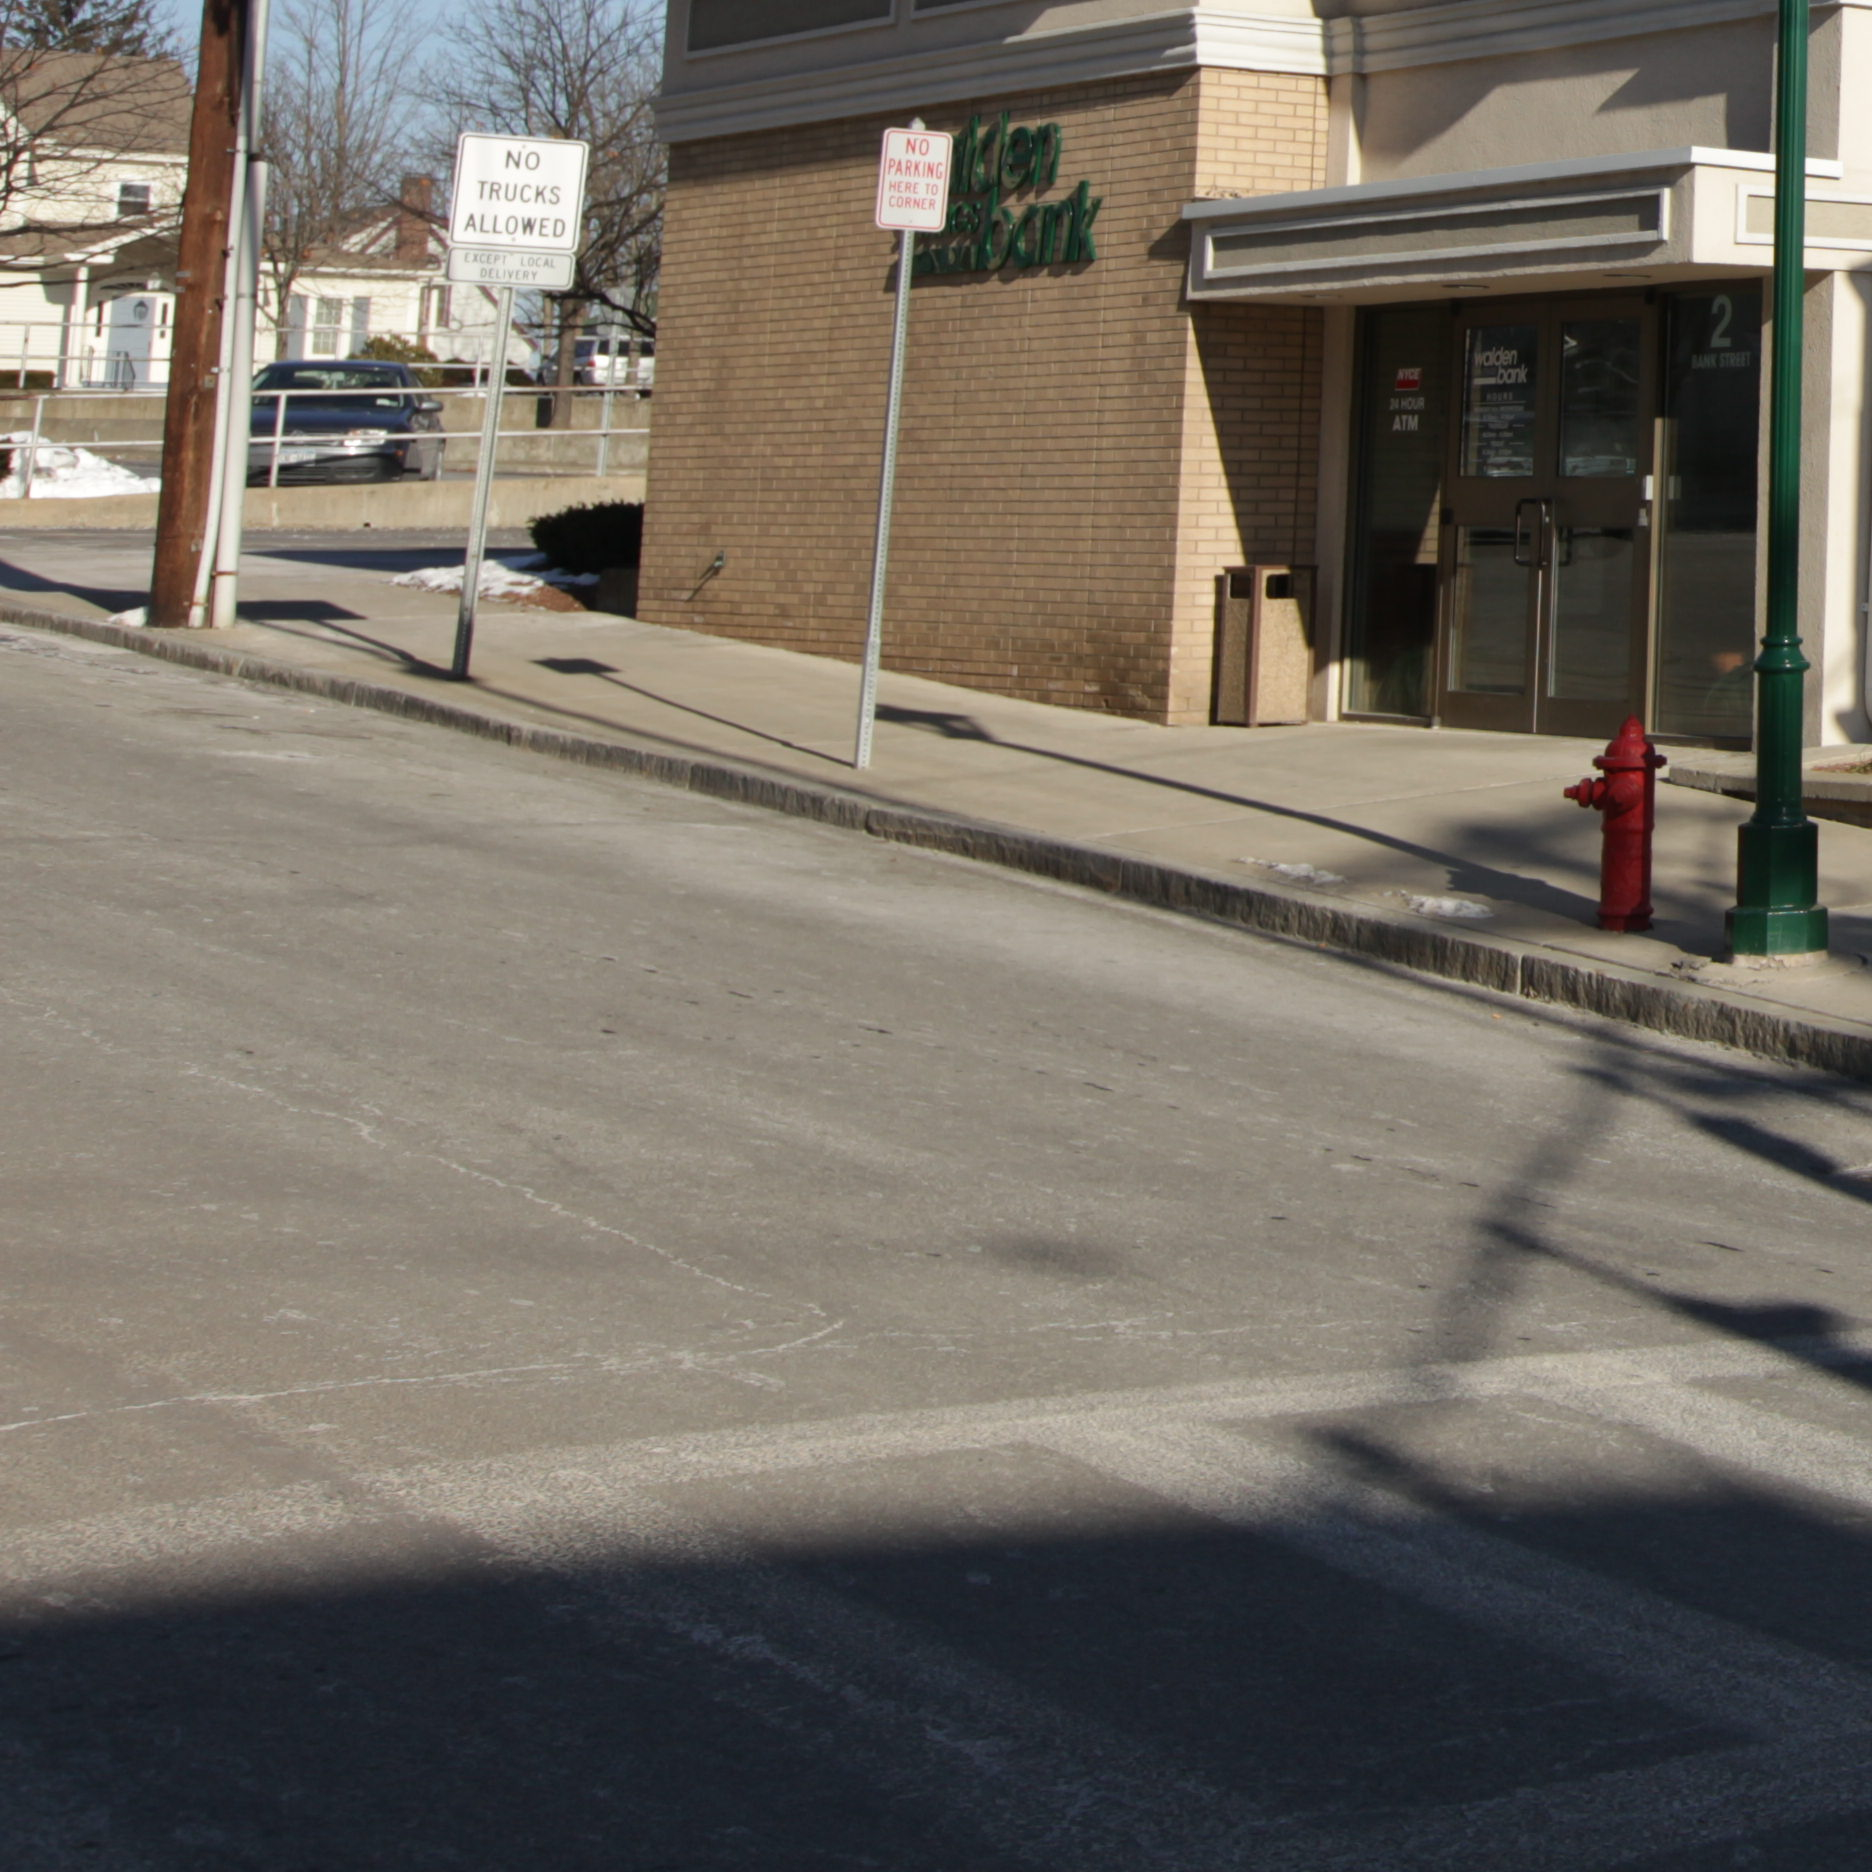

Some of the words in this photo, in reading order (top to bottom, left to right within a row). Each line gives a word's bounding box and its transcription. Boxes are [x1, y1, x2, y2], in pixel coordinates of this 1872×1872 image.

[905, 138, 930, 156] NO
[951, 111, 1061, 192] lden
[505, 150, 540, 171] NO
[887, 159, 943, 179] PARKING
[477, 180, 561, 205] TRUCKS
[888, 181, 919, 195] HERE
[924, 182, 938, 195] TO
[888, 195, 936, 210] CORNER
[464, 213, 566, 238] ALLOWED
[983, 180, 1103, 270] bank
[464, 253, 507, 265] EXCEPT
[520, 256, 556, 268] LOCAL
[480, 268, 538, 281] DELIVERY
[1710, 294, 1732, 348] 2
[1474, 347, 1518, 367] walden
[1496, 364, 1528, 384] bank
[1392, 415, 1419, 431] ATM
